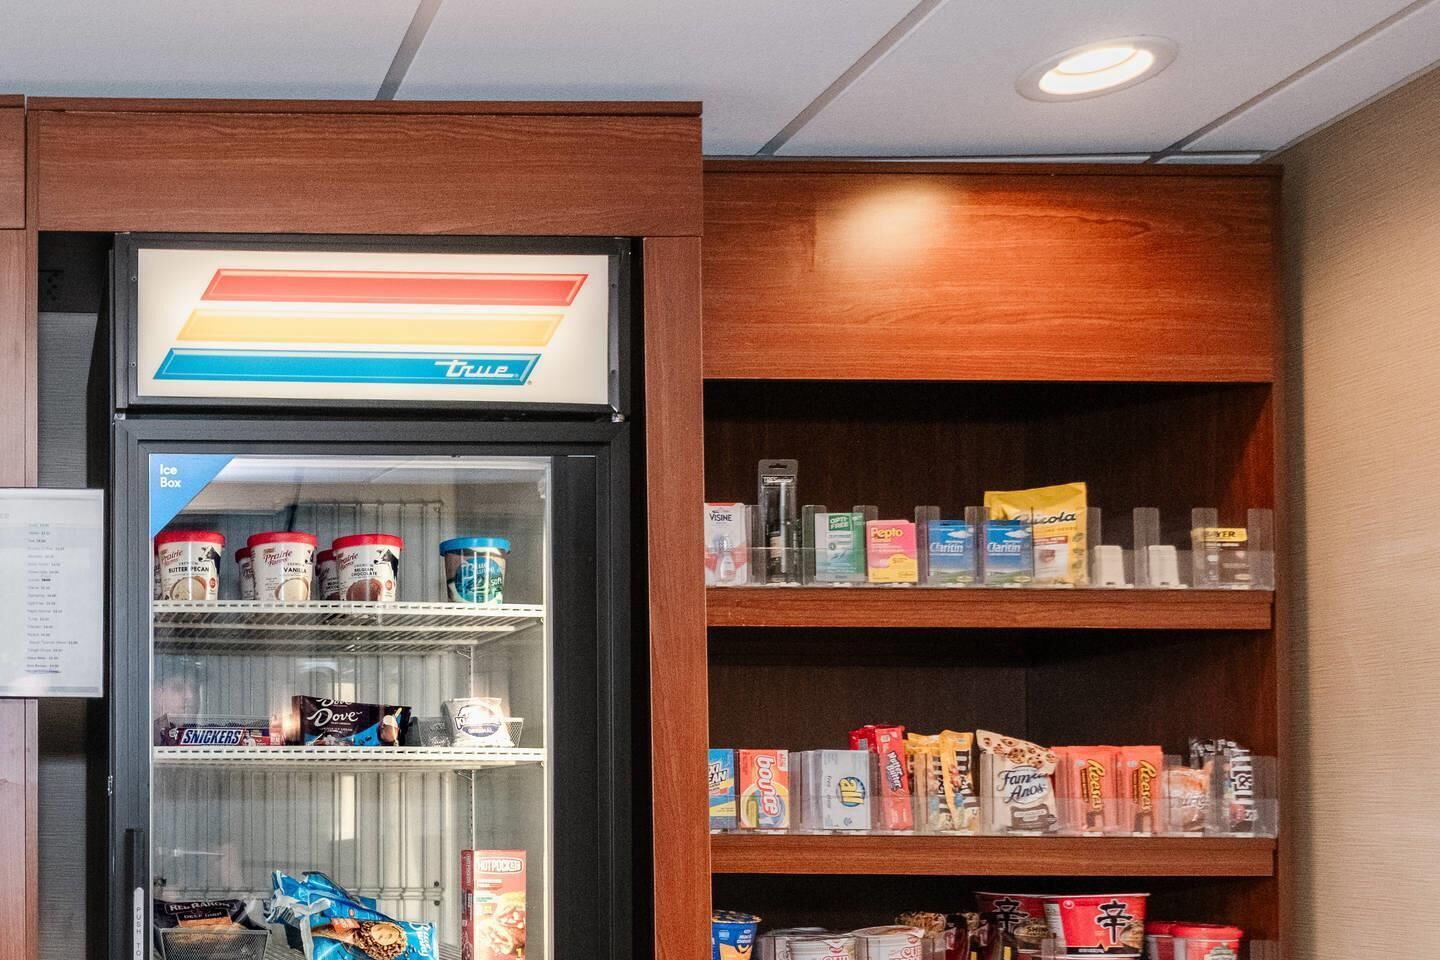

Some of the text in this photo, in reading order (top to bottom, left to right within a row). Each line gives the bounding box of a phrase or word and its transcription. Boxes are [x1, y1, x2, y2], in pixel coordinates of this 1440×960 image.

[434, 358, 521, 378] true
[160, 464, 177, 475] Ice
[160, 477, 181, 488] Box
[871, 527, 903, 538] Pepto
[929, 542, 964, 553] Claritin
[987, 542, 1021, 553] Claritin
[307, 708, 359, 727] Dove
[182, 728, 243, 745] SNICKERS
[755, 755, 779, 816] bounce
[1096, 900, 1133, 943] 辛
